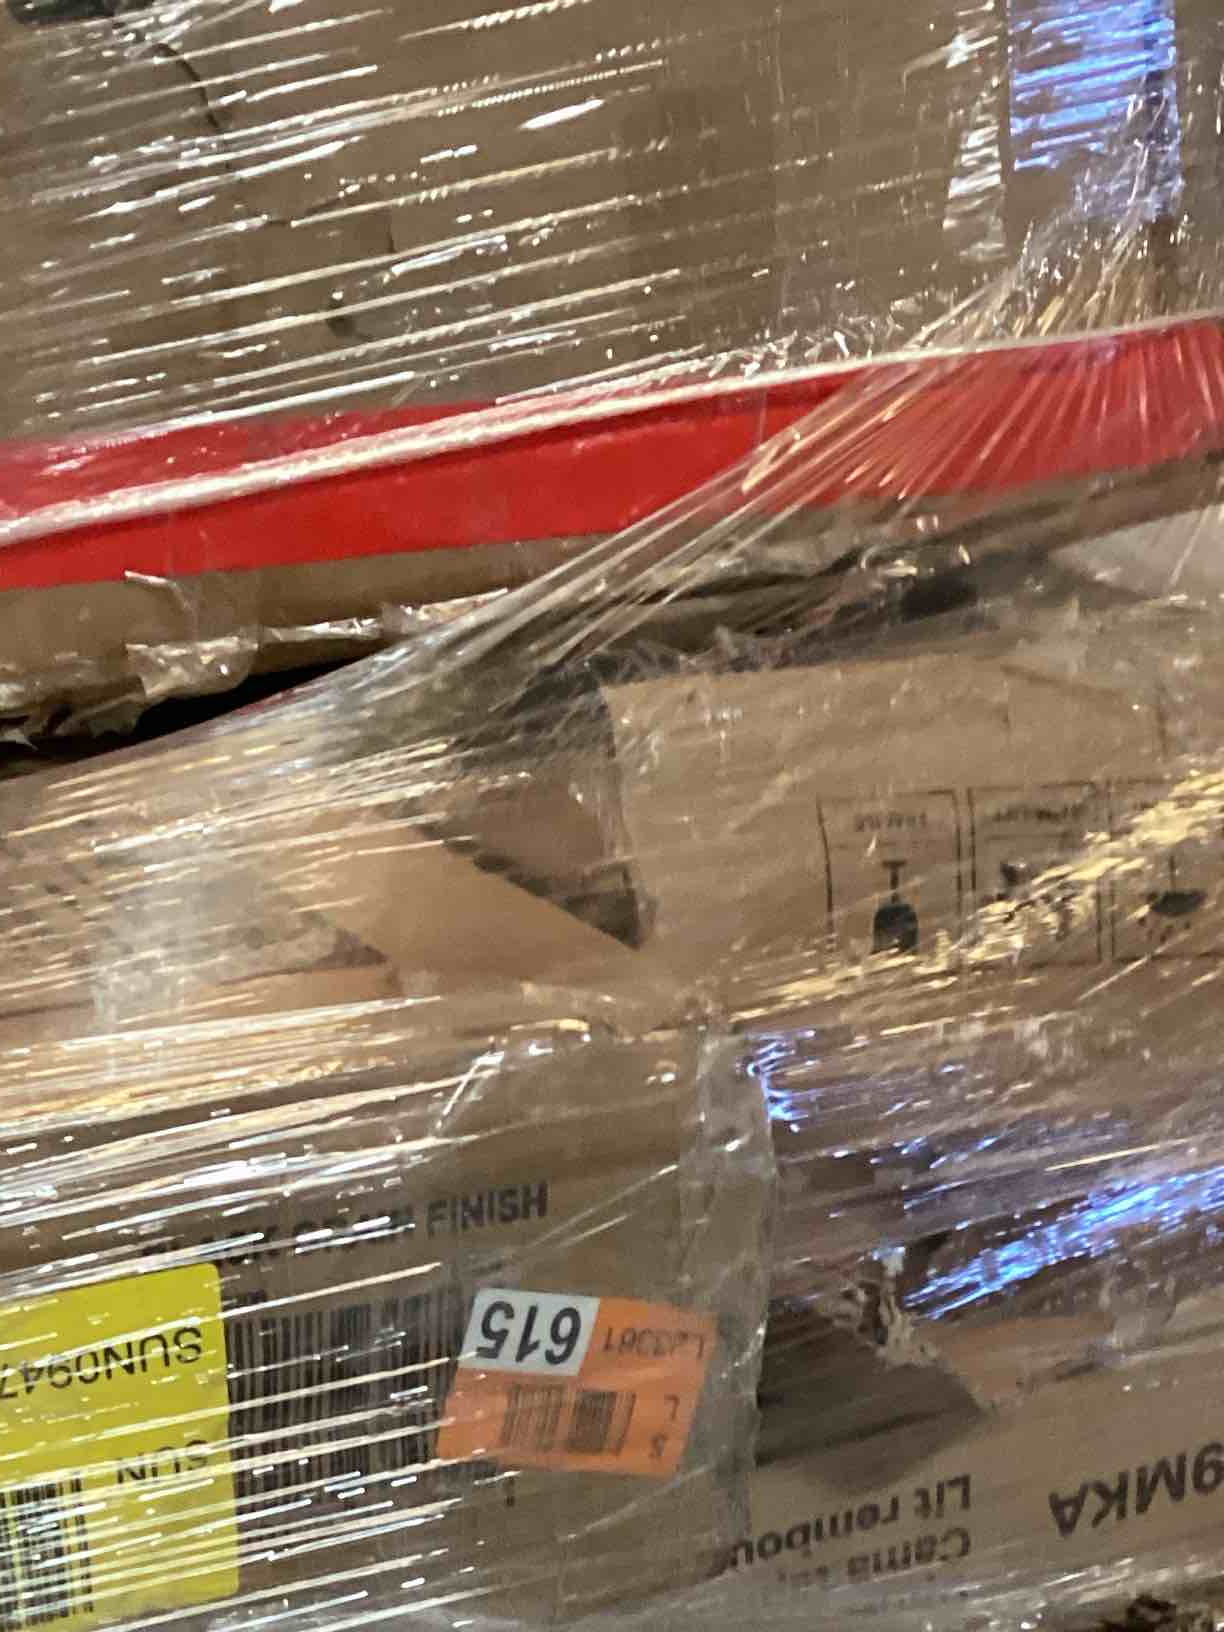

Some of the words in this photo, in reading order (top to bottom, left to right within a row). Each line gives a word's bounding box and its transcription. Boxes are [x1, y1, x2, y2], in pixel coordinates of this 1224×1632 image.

[426, 1183, 549, 1238] FINISH
[476, 1300, 582, 1366] 615
[114, 1438, 210, 1487] SUN
